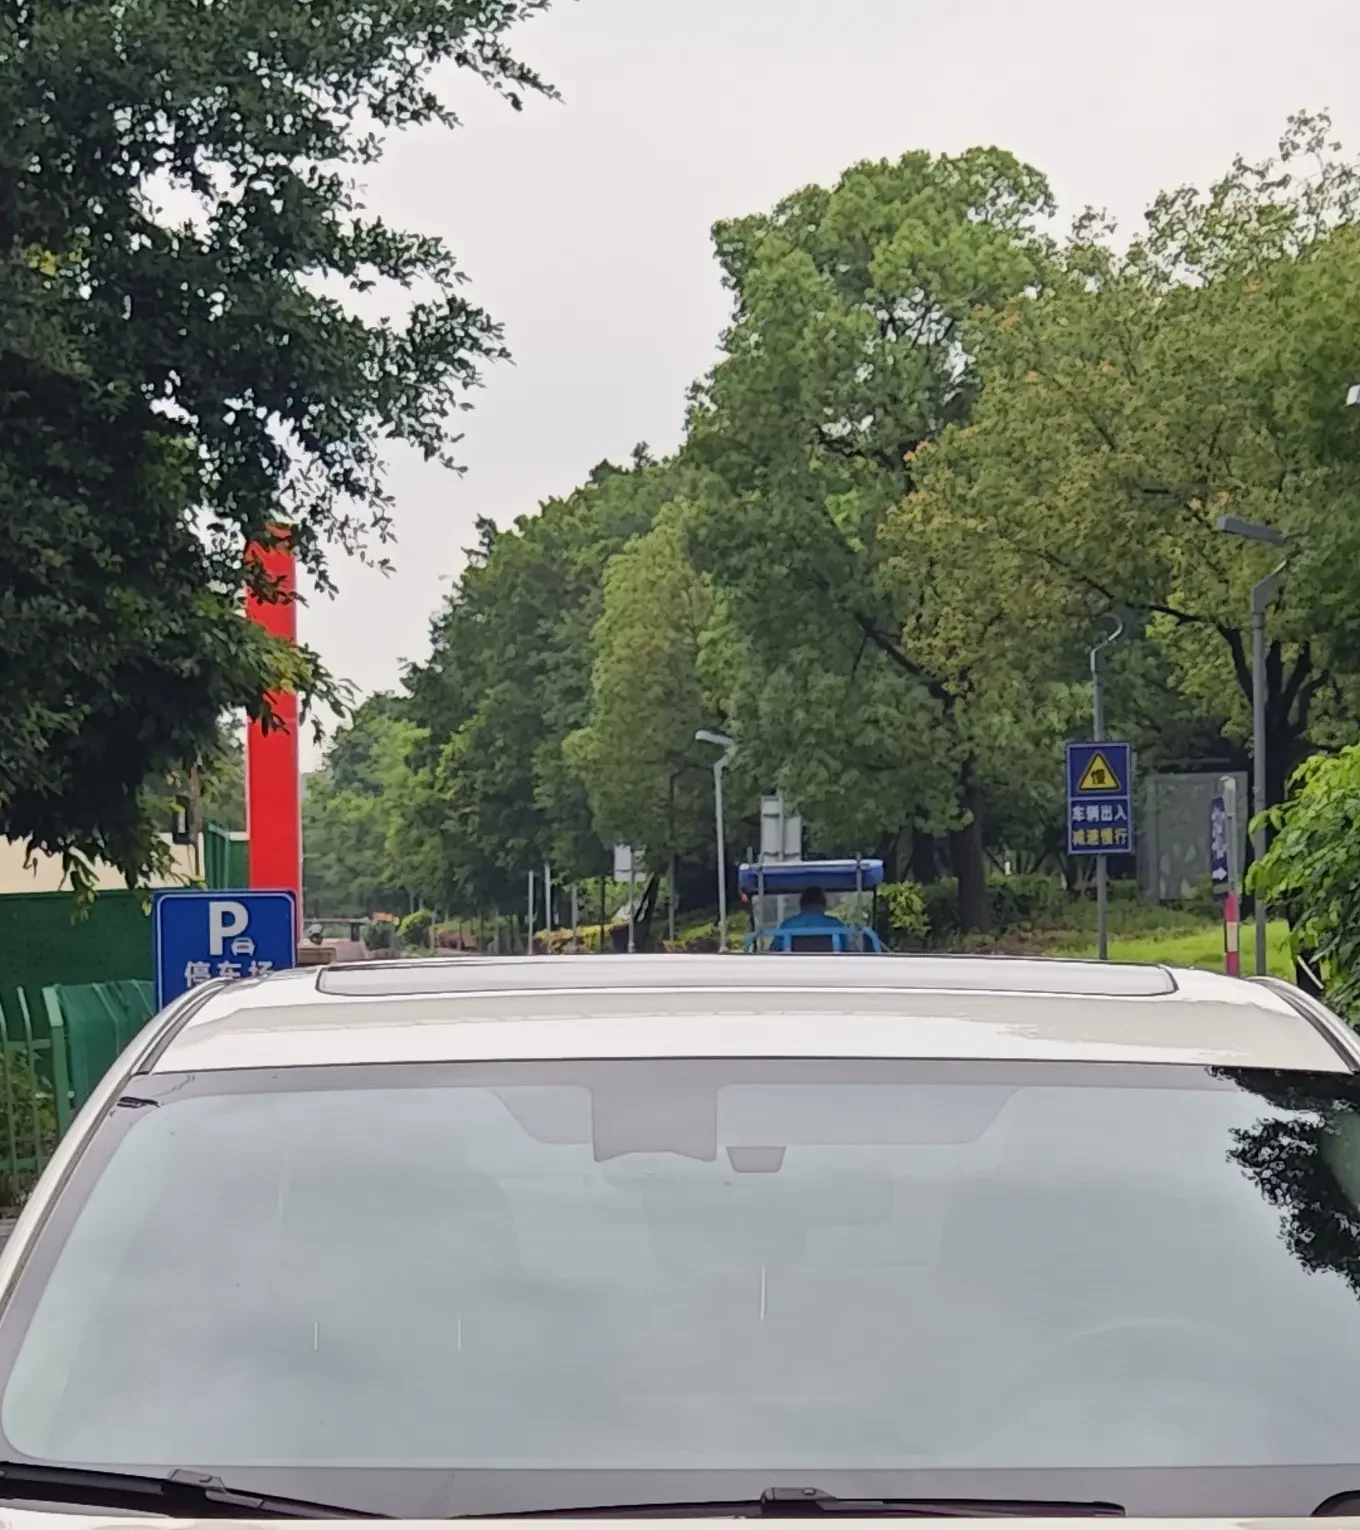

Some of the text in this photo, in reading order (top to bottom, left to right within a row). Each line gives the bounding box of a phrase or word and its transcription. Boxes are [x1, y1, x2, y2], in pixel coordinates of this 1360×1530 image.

[1072, 804, 1127, 822] 车辆出入
[209, 901, 248, 956] P
